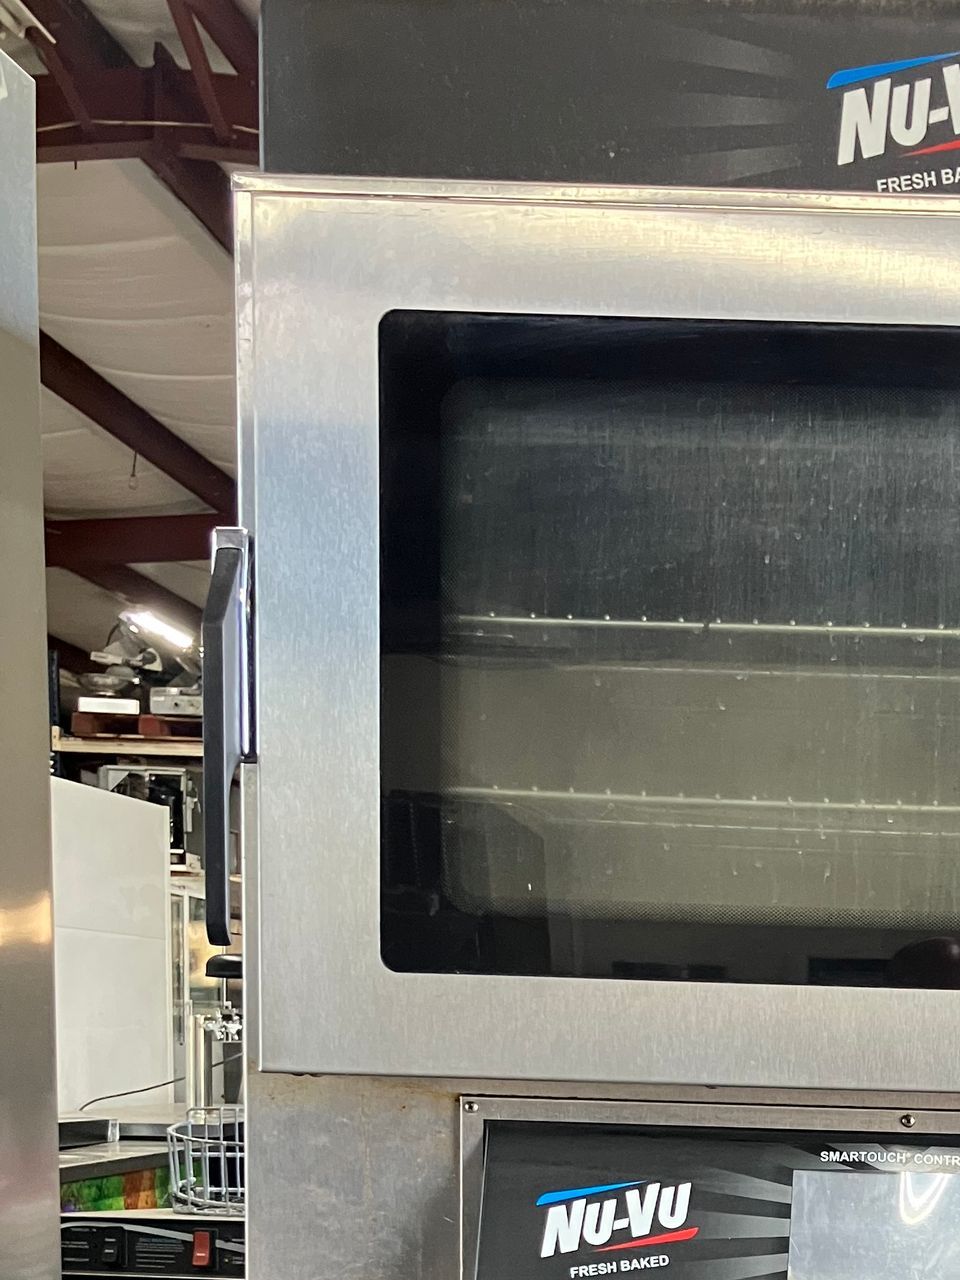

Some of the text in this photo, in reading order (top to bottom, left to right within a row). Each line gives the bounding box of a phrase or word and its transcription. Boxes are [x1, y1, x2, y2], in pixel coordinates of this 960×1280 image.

[876, 170, 938, 193] FRESH
[569, 1254, 670, 1279] FRESH BAKED
